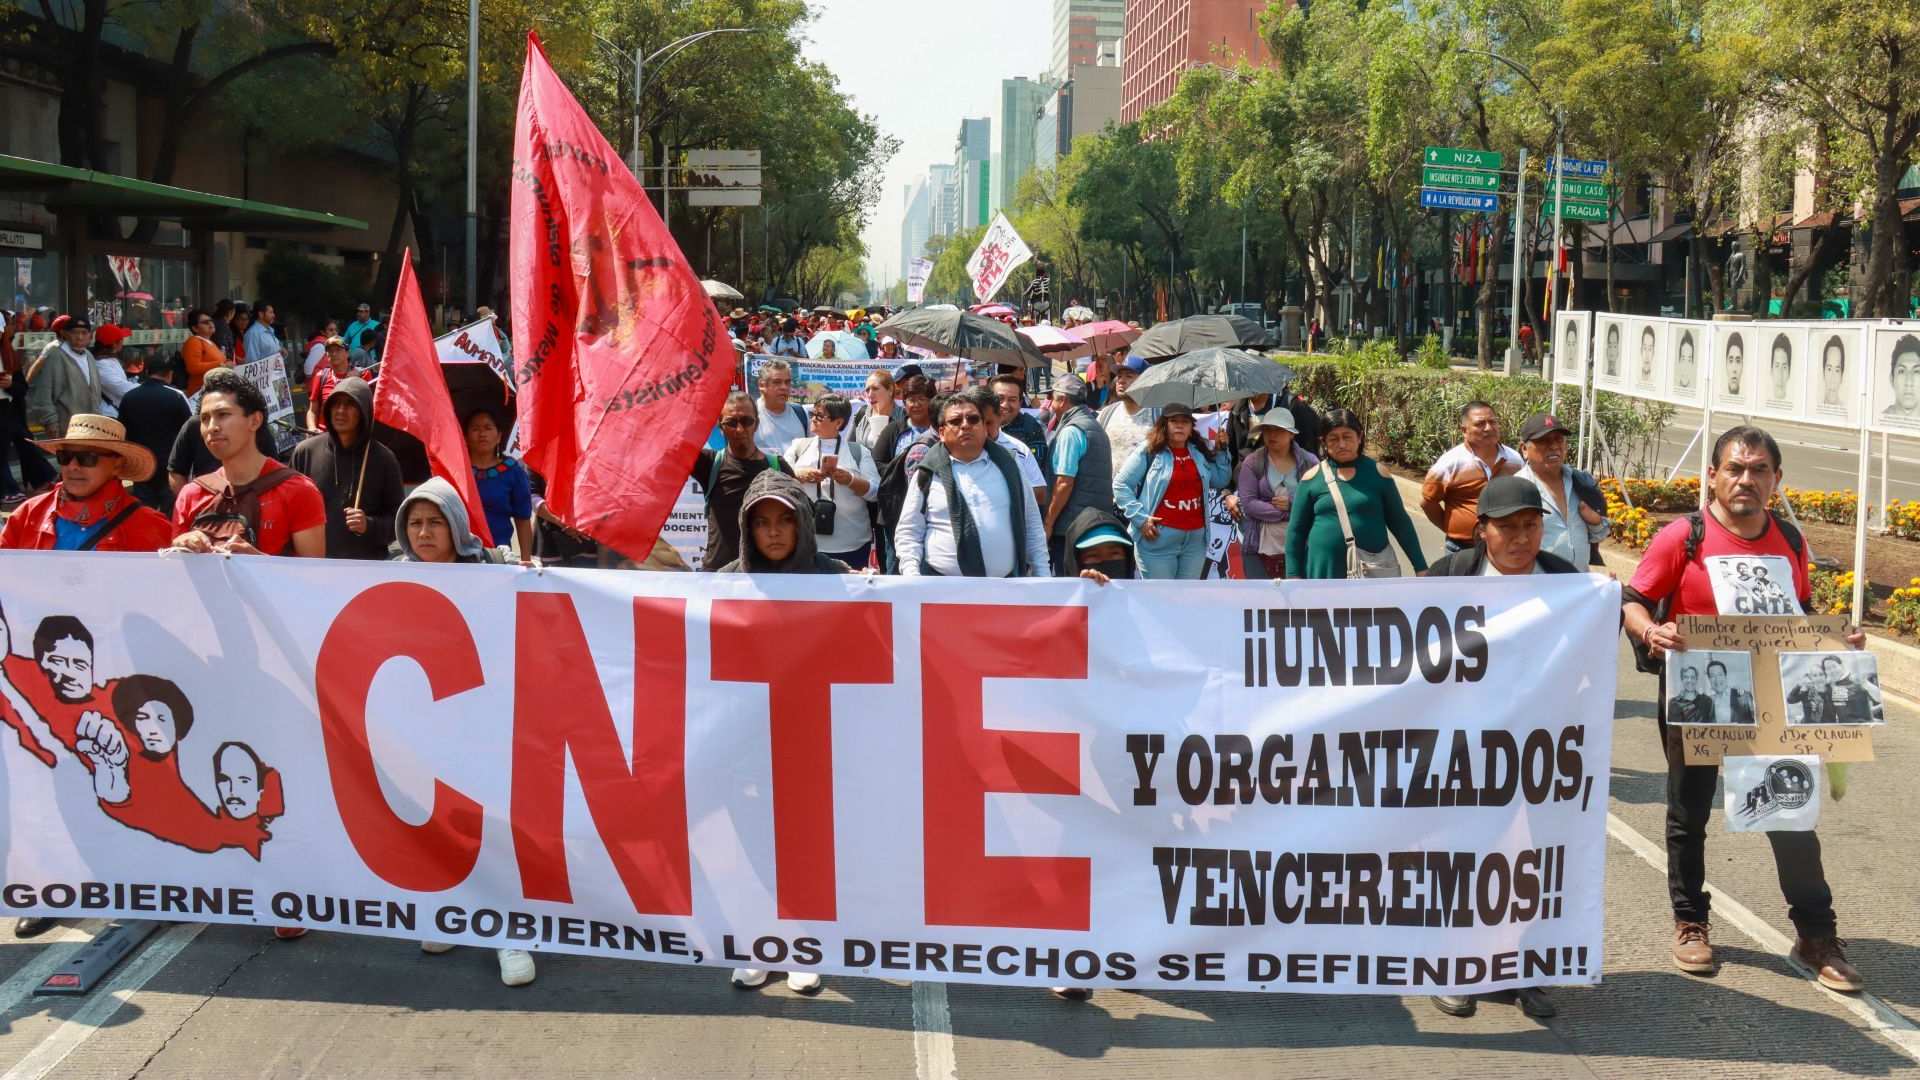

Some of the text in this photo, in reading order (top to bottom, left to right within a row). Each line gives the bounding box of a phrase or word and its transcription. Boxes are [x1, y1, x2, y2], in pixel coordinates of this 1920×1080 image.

[1454, 153, 1482, 164] NIZA
[1429, 172, 1484, 185] INSURGENTES CENTRO
[1550, 183, 1604, 196] ATONIO CASO
[1439, 195, 1447, 205] LA
[1566, 205, 1601, 217] FRAGUA
[663, 524, 708, 533] DOCENT
[1735, 596, 1794, 615] CNTE
[1743, 618, 1760, 634] de
[1764, 617, 1833, 638] confianza
[1244, 605, 1488, 688] ¡¡UNIDOS
[1814, 728, 1864, 741] CLAUDIA
[315, 581, 1091, 932] CNTE
[1126, 725, 1594, 812] Y ORGANIZADOS,
[1153, 845, 1565, 928] VENCEREMOS!!
[2, 882, 1589, 987] GOBIERNE QUIEN GOBIERNE, LOS DERECHOS SE DEFIENDEN!!
